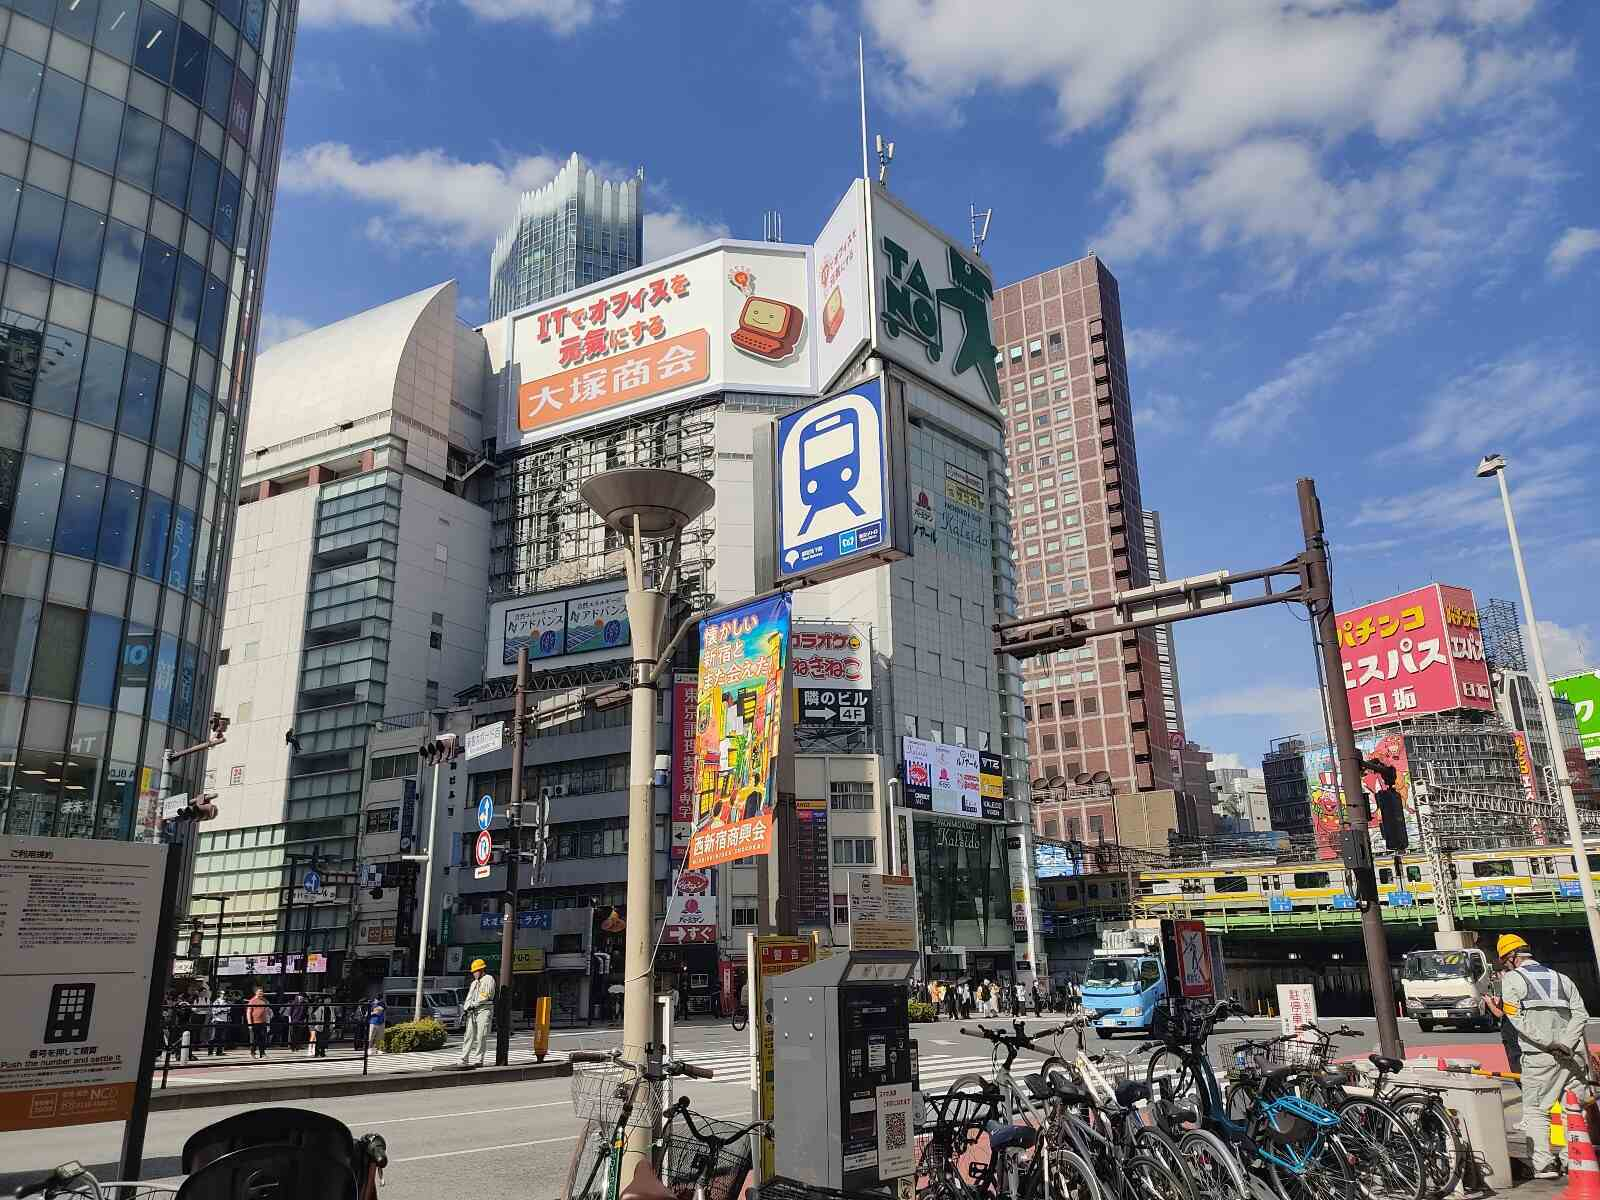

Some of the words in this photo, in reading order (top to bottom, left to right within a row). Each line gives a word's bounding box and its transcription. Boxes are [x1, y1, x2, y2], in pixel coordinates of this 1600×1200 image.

[537, 274, 690, 343] ITでオフィスを
[529, 344, 696, 417] 大塚商会
[1337, 604, 1425, 648] パチンコ
[704, 640, 744, 668] 新宿と
[805, 691, 868, 706] 隣のビル
[1364, 685, 1417, 718] 日拓
[843, 709, 865, 719] 4F
[687, 926, 712, 940] すぐ
